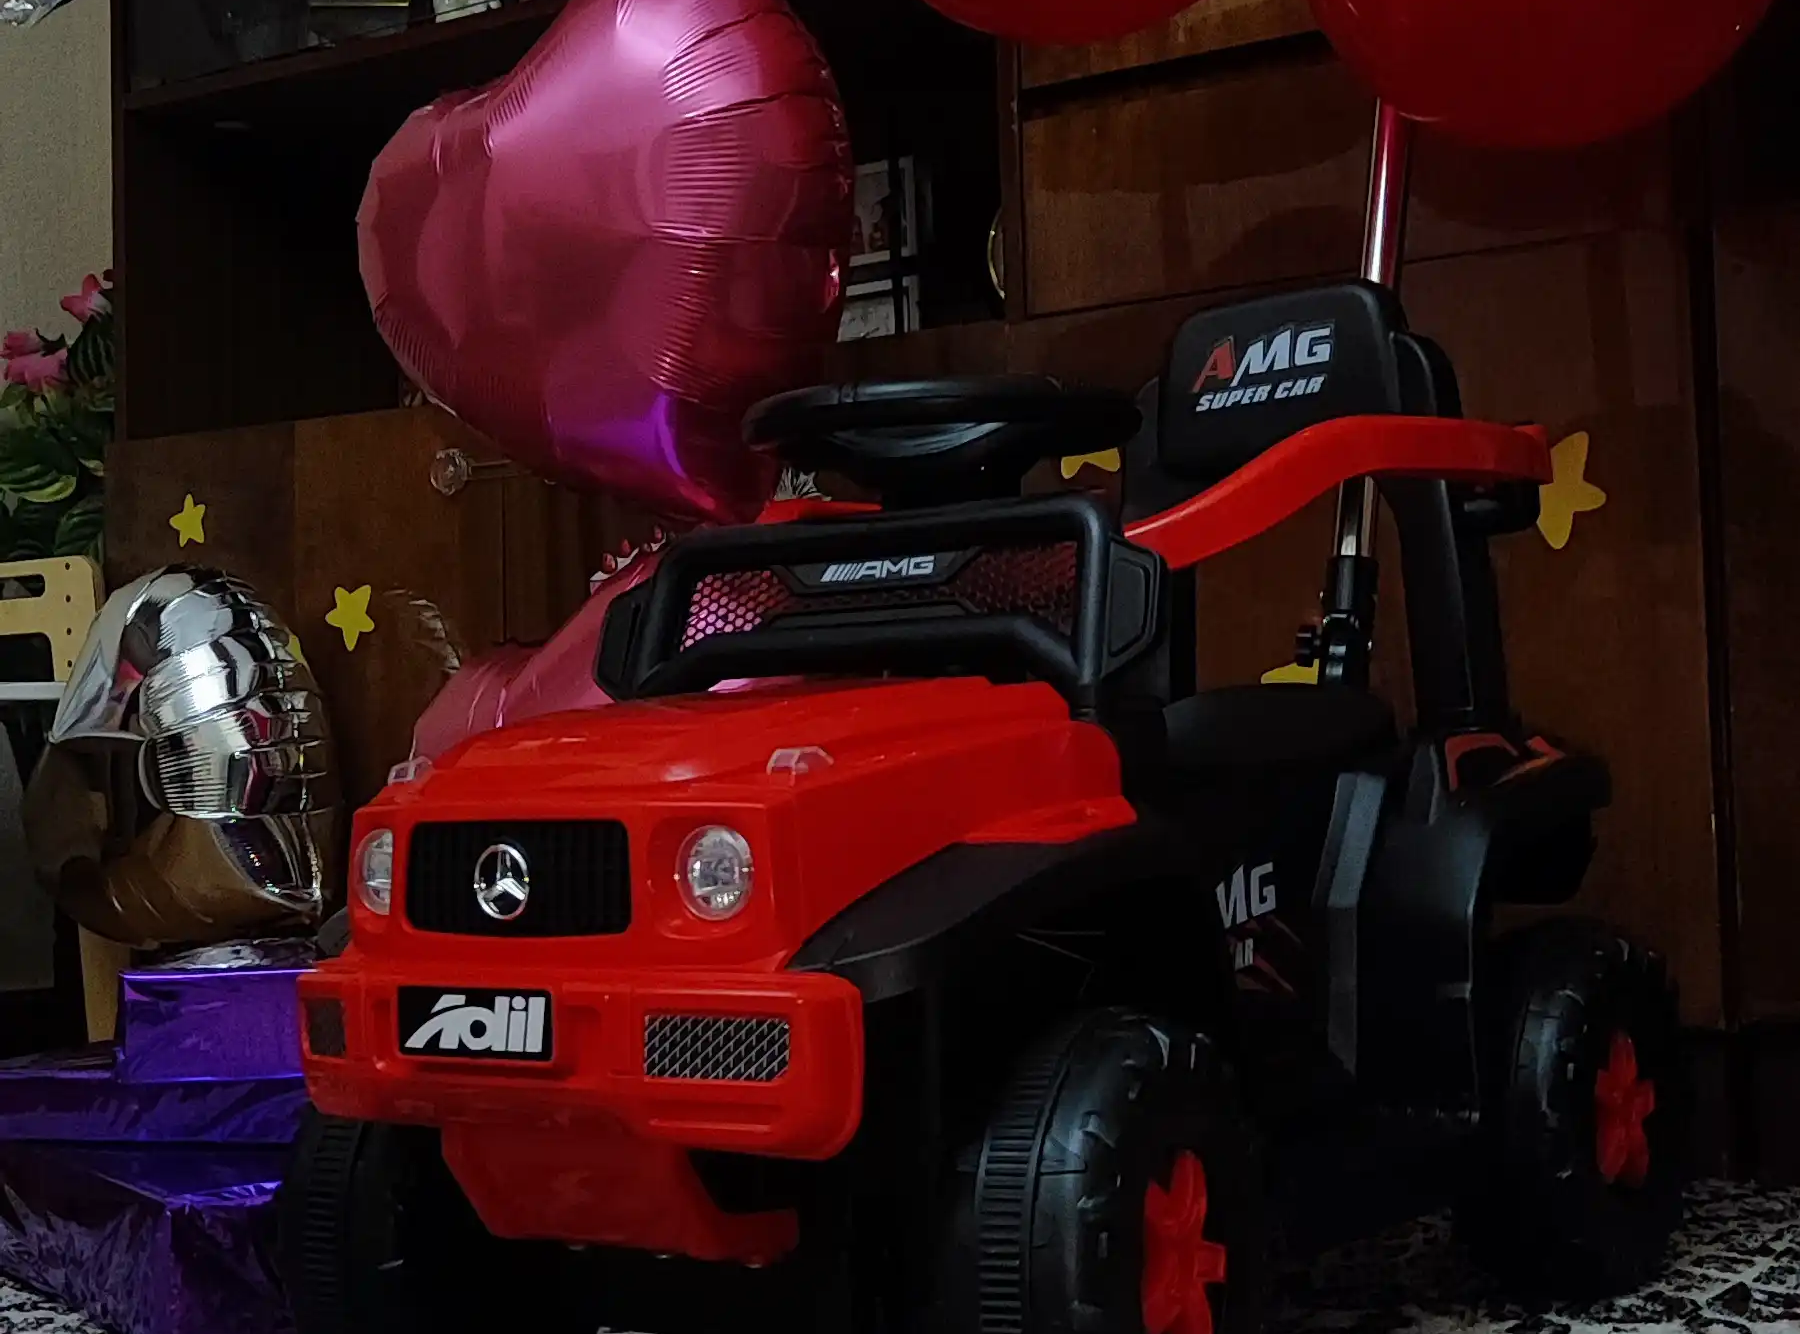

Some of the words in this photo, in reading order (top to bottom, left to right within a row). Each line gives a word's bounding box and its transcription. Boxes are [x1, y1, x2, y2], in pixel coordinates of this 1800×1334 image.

[1190, 322, 1334, 394] AMG
[1194, 382, 1272, 413] SUPER
[1273, 372, 1327, 400] CAR
[1214, 861, 1277, 930] MG
[404, 993, 546, 1053] Adil
